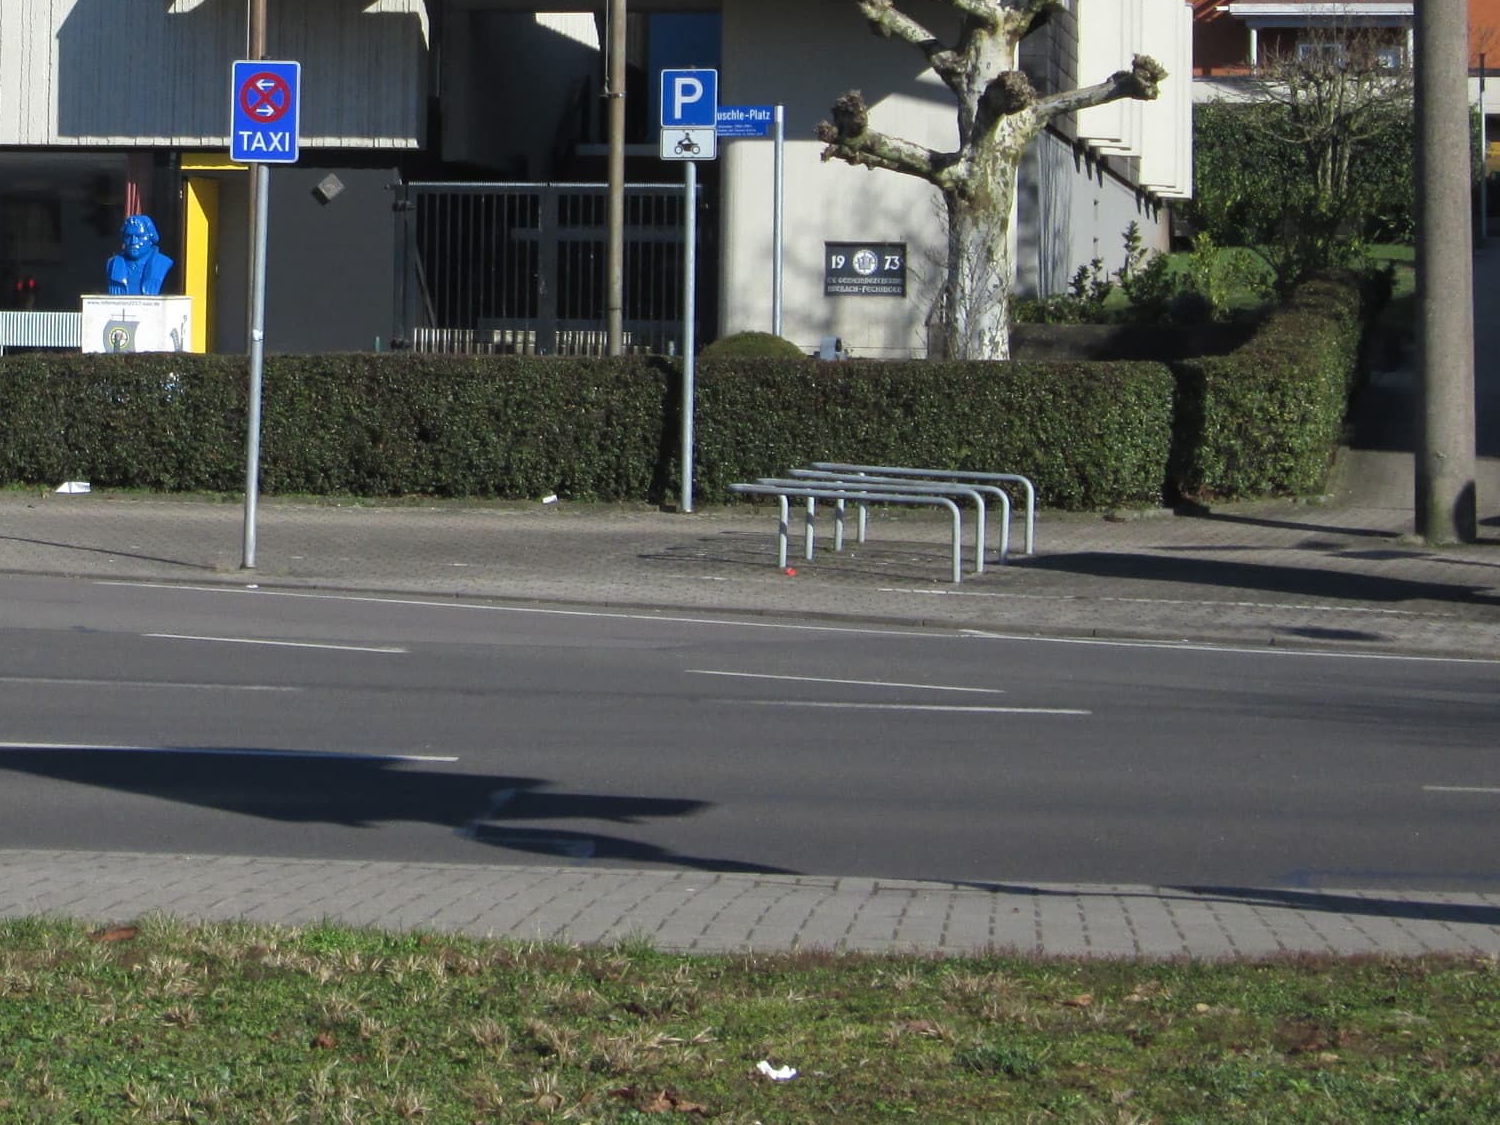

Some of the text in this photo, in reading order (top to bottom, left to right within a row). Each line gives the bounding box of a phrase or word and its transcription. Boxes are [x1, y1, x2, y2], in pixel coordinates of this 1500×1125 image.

[674, 77, 704, 120] P
[716, 109, 771, 121] uschle-Platz
[238, 130, 290, 152] TAXI
[831, 255, 846, 269] 19
[884, 255, 900, 271] 73
